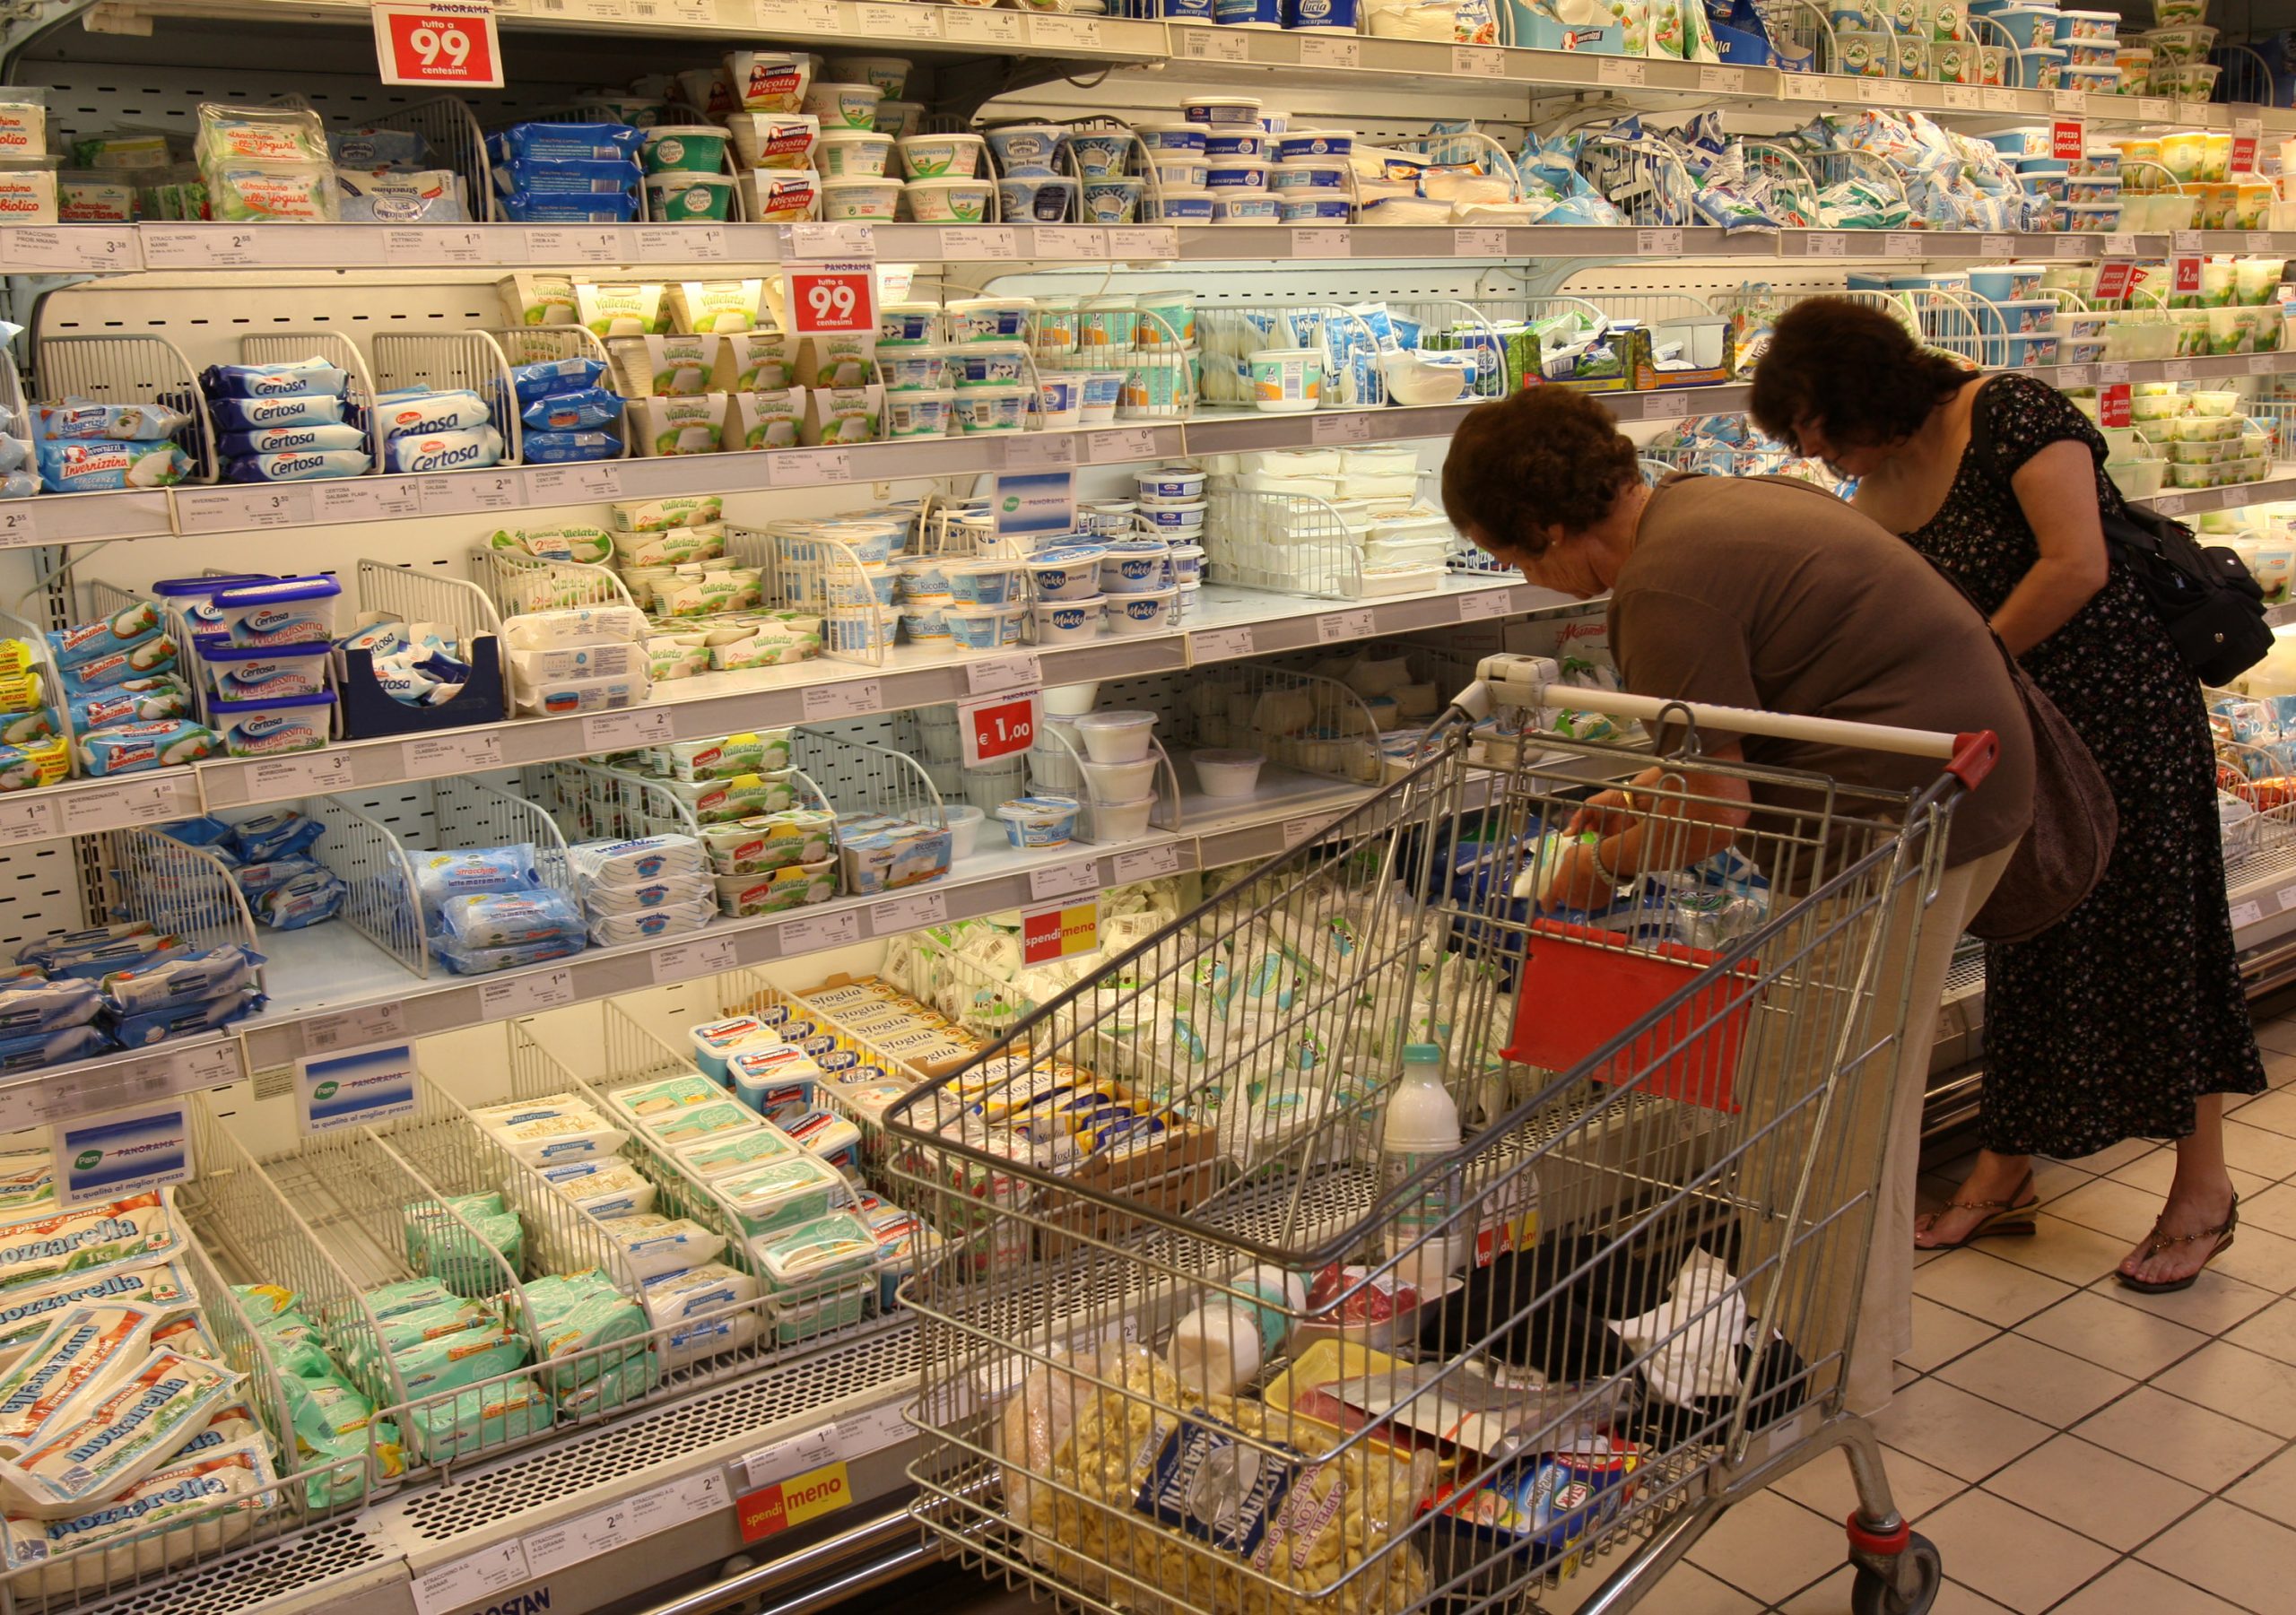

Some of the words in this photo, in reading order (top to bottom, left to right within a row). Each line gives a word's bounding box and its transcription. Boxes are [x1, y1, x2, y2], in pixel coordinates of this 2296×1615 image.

[430, 4, 490, 13] PANORAMA
[422, 20, 444, 30] tutto
[410, 30, 470, 66] 99
[422, 66, 466, 75] centesimi
[754, 78, 796, 90] Ricotta
[2056, 130, 2079, 141] prezzo
[770, 138, 808, 151] Ricotta
[2054, 140, 2081, 152] speciale
[770, 195, 809, 206] Ricotta
[818, 279, 835, 287] tutto
[595, 298, 642, 312] Vallelata
[700, 294, 745, 307] Vallelata
[808, 287, 856, 319] 99
[816, 317, 854, 326] centesimi
[662, 347, 704, 360] Vallelata
[746, 347, 785, 360] Vallelata
[827, 343, 865, 356] Vallelata
[255, 378, 306, 397] Certosa
[253, 402, 305, 421] Certosa
[754, 402, 794, 415] Vallelata
[830, 399, 868, 412] Vallelata
[665, 408, 710, 421] Vallelata
[389, 413, 458, 438] Certosa
[261, 431, 315, 449] Certosa
[271, 455, 323, 475] Certosa
[412, 444, 478, 472] Certosa
[65, 457, 127, 476] Invernizzina
[1029, 498, 1064, 506] PANORAMA
[662, 540, 700, 551] Vallelata
[1121, 565, 1151, 577] Mukki
[1039, 573, 1065, 586] Mukki
[700, 584, 738, 595] Vallelata
[1127, 604, 1156, 617] Mukki
[255, 612, 289, 627] Certosa
[1053, 612, 1083, 627] Mukki
[253, 621, 323, 646] Morbidissima
[752, 637, 793, 648] Vallelata
[241, 665, 275, 678] Certosa
[234, 673, 306, 697] Morbidissima
[1003, 689, 1038, 701] PANORAMA
[248, 717, 282, 731] Certosa
[978, 734, 988, 745] €
[995, 717, 1030, 742] 1,00
[243, 727, 313, 750] Morbidissima
[722, 744, 763, 758] Vallelata
[726, 788, 767, 801] Vallelata
[765, 837, 804, 851] Vallelata
[455, 866, 499, 876] Stracchino
[770, 879, 809, 893] Vallelata
[1025, 926, 1061, 948] spendi
[1062, 921, 1096, 937] meno
[810, 987, 862, 1005] Sfoglia
[832, 1003, 886, 1021] Sfoglia
[857, 1016, 910, 1035] Sfoglia
[879, 1030, 934, 1049] Sfoglia
[317, 1086, 336, 1096] Pam
[352, 1072, 404, 1088] PANORAMA
[322, 1116, 348, 1128] qualità
[351, 1114, 359, 1122] al
[360, 1109, 387, 1121] miglior
[388, 1104, 413, 1116] prezzo
[79, 1154, 99, 1165] Pam
[117, 1140, 175, 1157] PANORAMA
[72, 1193, 80, 1201] la
[83, 1186, 112, 1200] qualità
[115, 1184, 124, 1192] al
[126, 1178, 154, 1191] miglior
[157, 1172, 185, 1185] prezzo
[65, 1377, 188, 1463] mozzarella
[46, 1477, 228, 1539] mozzarella
[746, 1502, 783, 1529] spendi
[787, 1477, 842, 1510] meno
[423, 1567, 457, 1586] STRACCHINO
